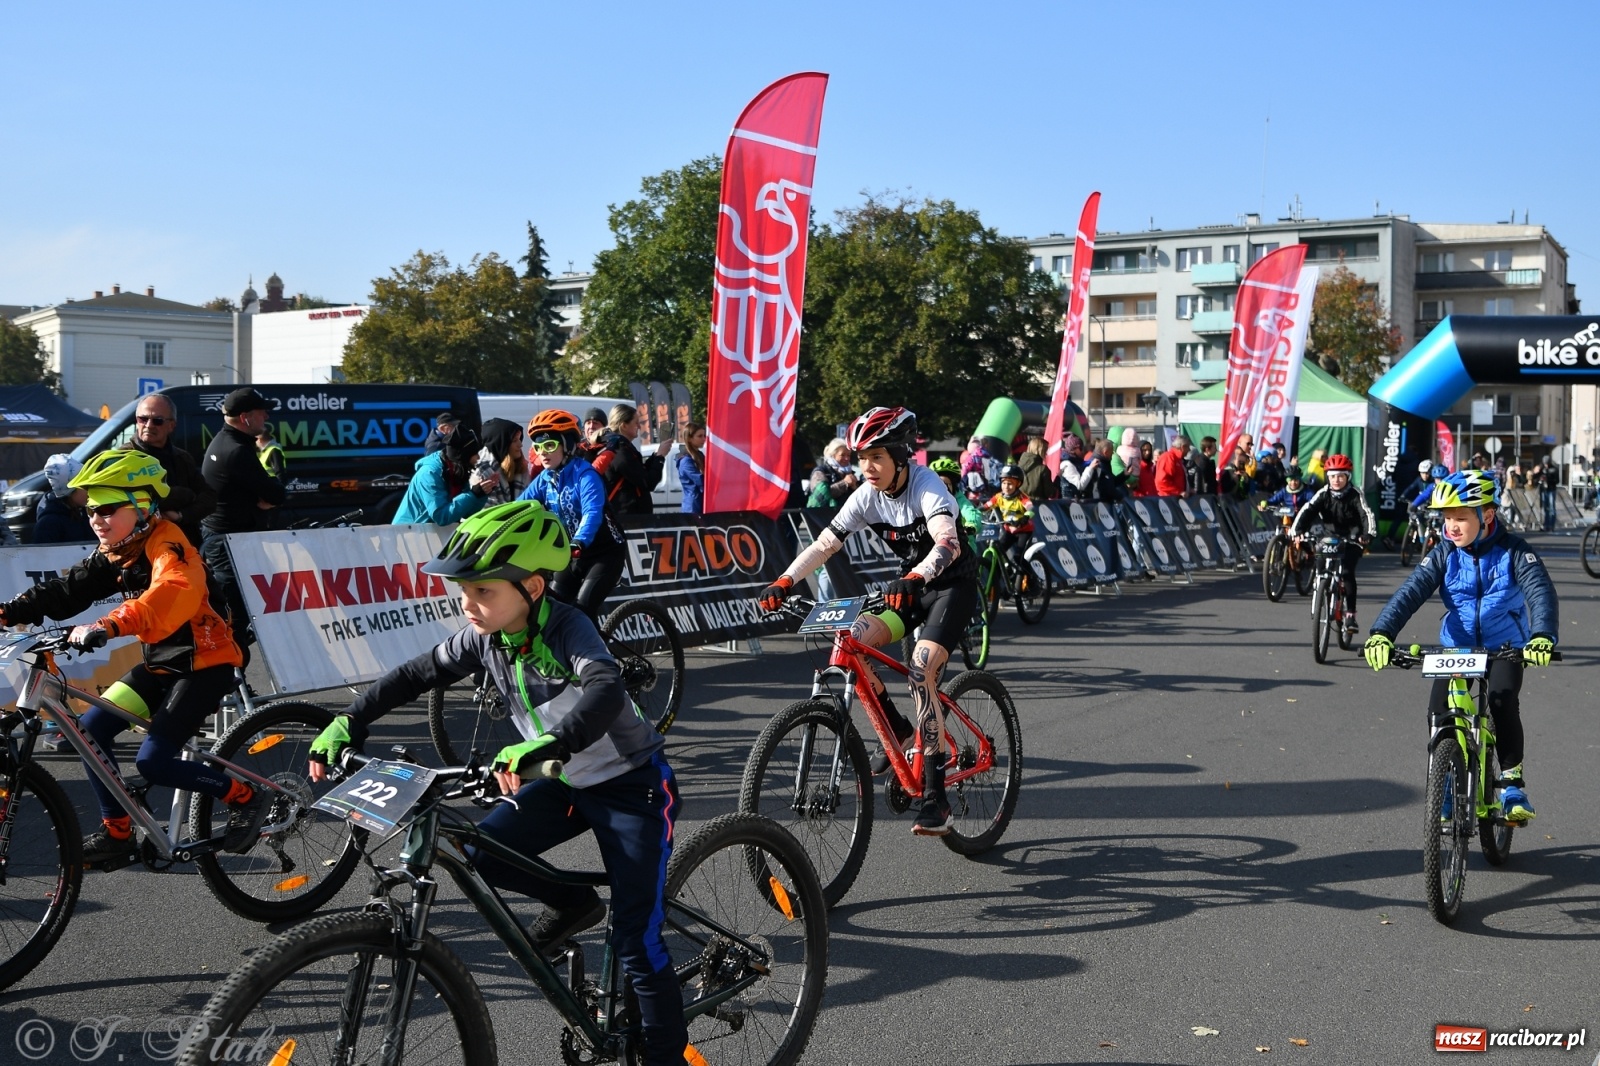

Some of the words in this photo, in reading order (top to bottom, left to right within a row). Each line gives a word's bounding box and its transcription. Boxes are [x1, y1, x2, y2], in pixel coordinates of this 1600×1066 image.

[1518, 338, 1578, 366] bike
[287, 392, 348, 411] atelier
[296, 482, 319, 490] atelier
[1380, 477, 1396, 511] bike
[982, 529, 994, 537] 220
[619, 525, 765, 587] EZADO
[250, 562, 448, 614] YAKIMA
[320, 616, 366, 644] TAKE
[366, 607, 414, 635] MORE
[414, 597, 465, 624] FRIEN
[816, 610, 846, 622] 303
[1435, 658, 1476, 668] 3098
[347, 779, 398, 808] 222
